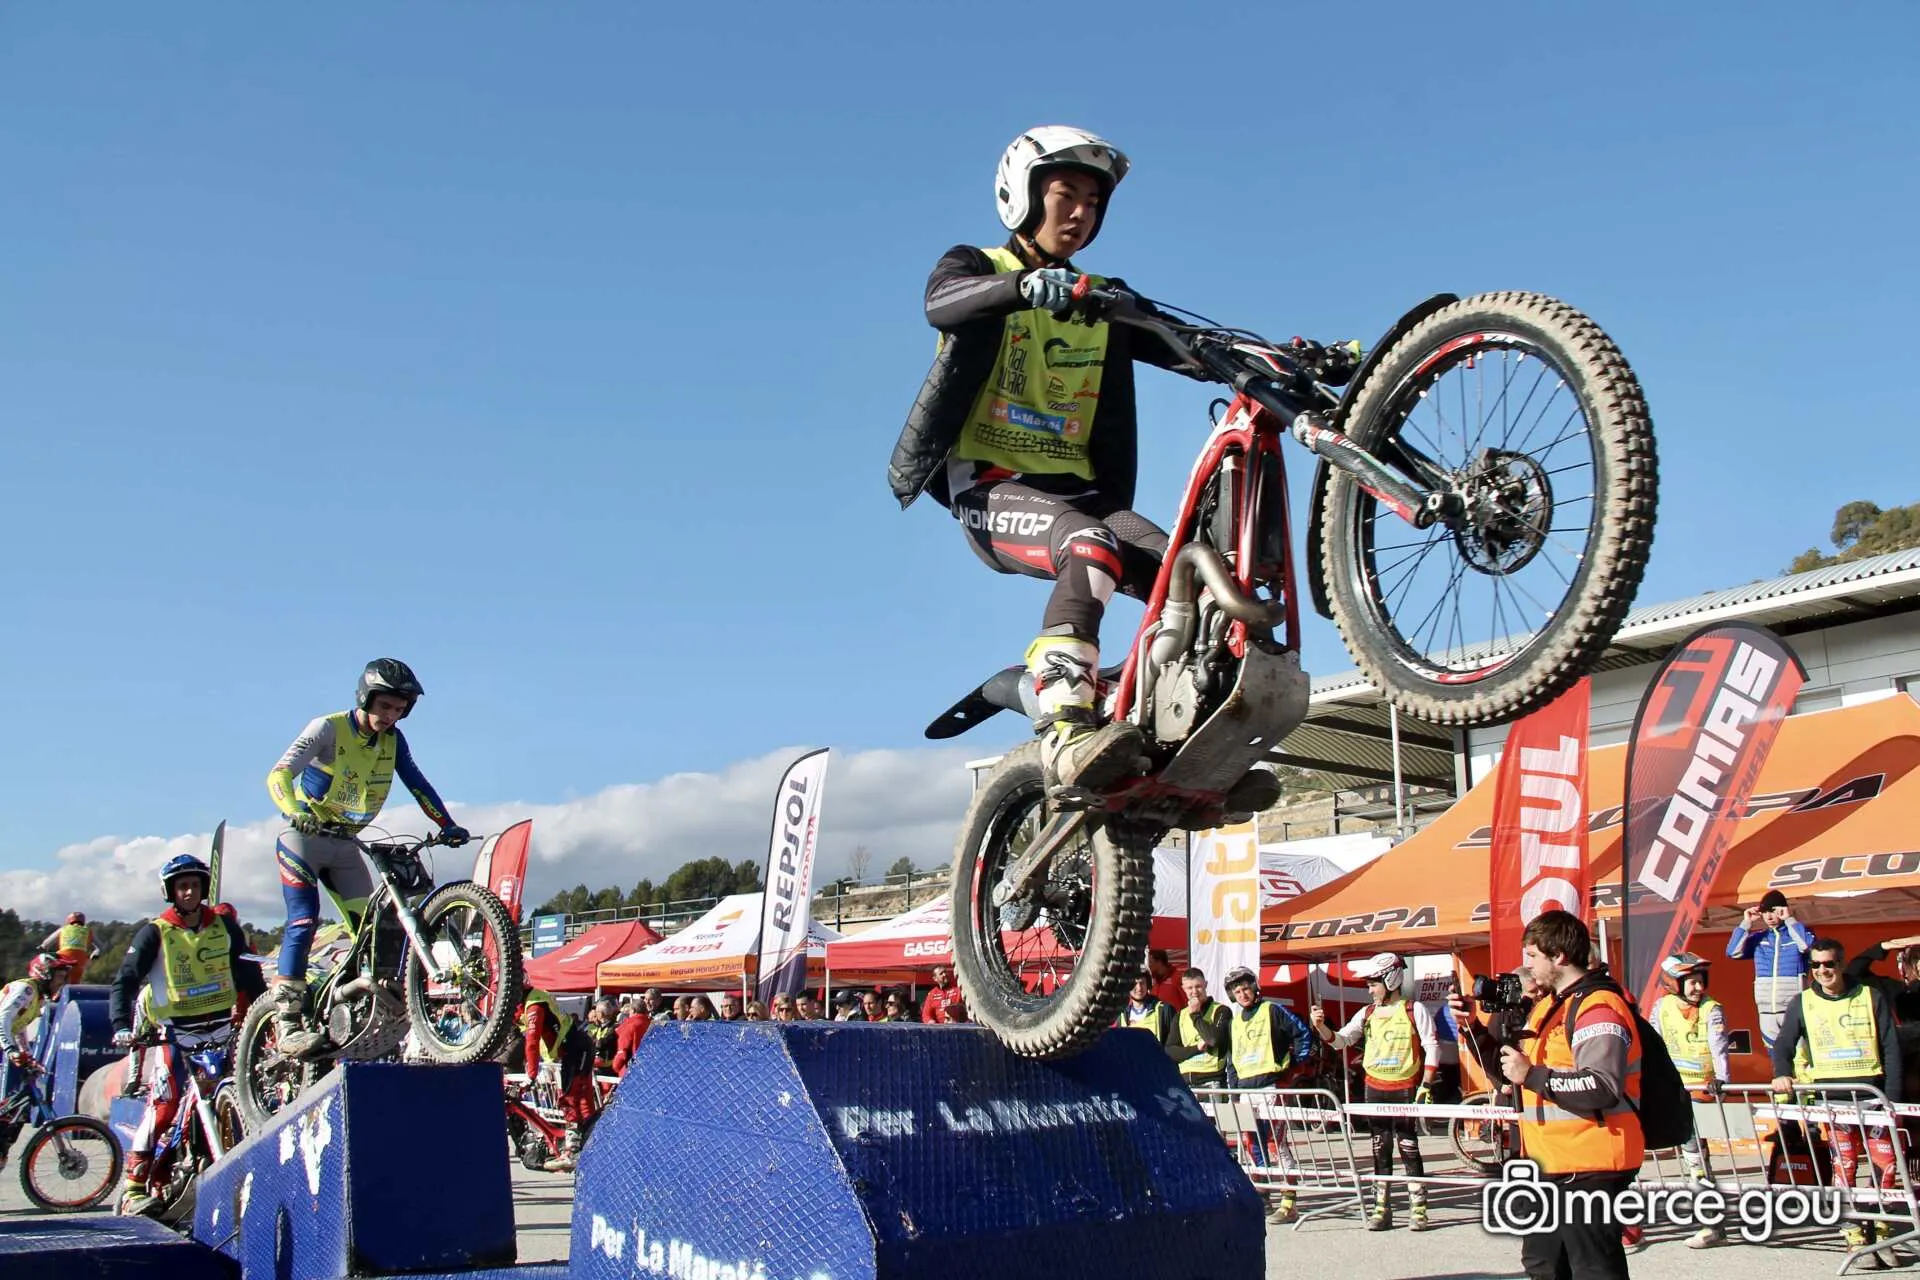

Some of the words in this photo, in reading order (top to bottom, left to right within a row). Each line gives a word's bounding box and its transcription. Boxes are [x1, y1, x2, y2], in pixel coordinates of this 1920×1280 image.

[1638, 641, 1779, 902] COMAS
[1520, 735, 1581, 928] OTUL
[773, 776, 808, 933] REPSOL
[1769, 851, 1920, 889] SCO
[1260, 906, 1437, 943] SCORPA
[904, 940, 953, 958] GASGA
[1437, 982, 1449, 991] TH
[1551, 1074, 1597, 1093] ALWAYSG
[843, 1106, 915, 1138] Per
[591, 1213, 626, 1261] Per
[636, 1228, 664, 1272] La
